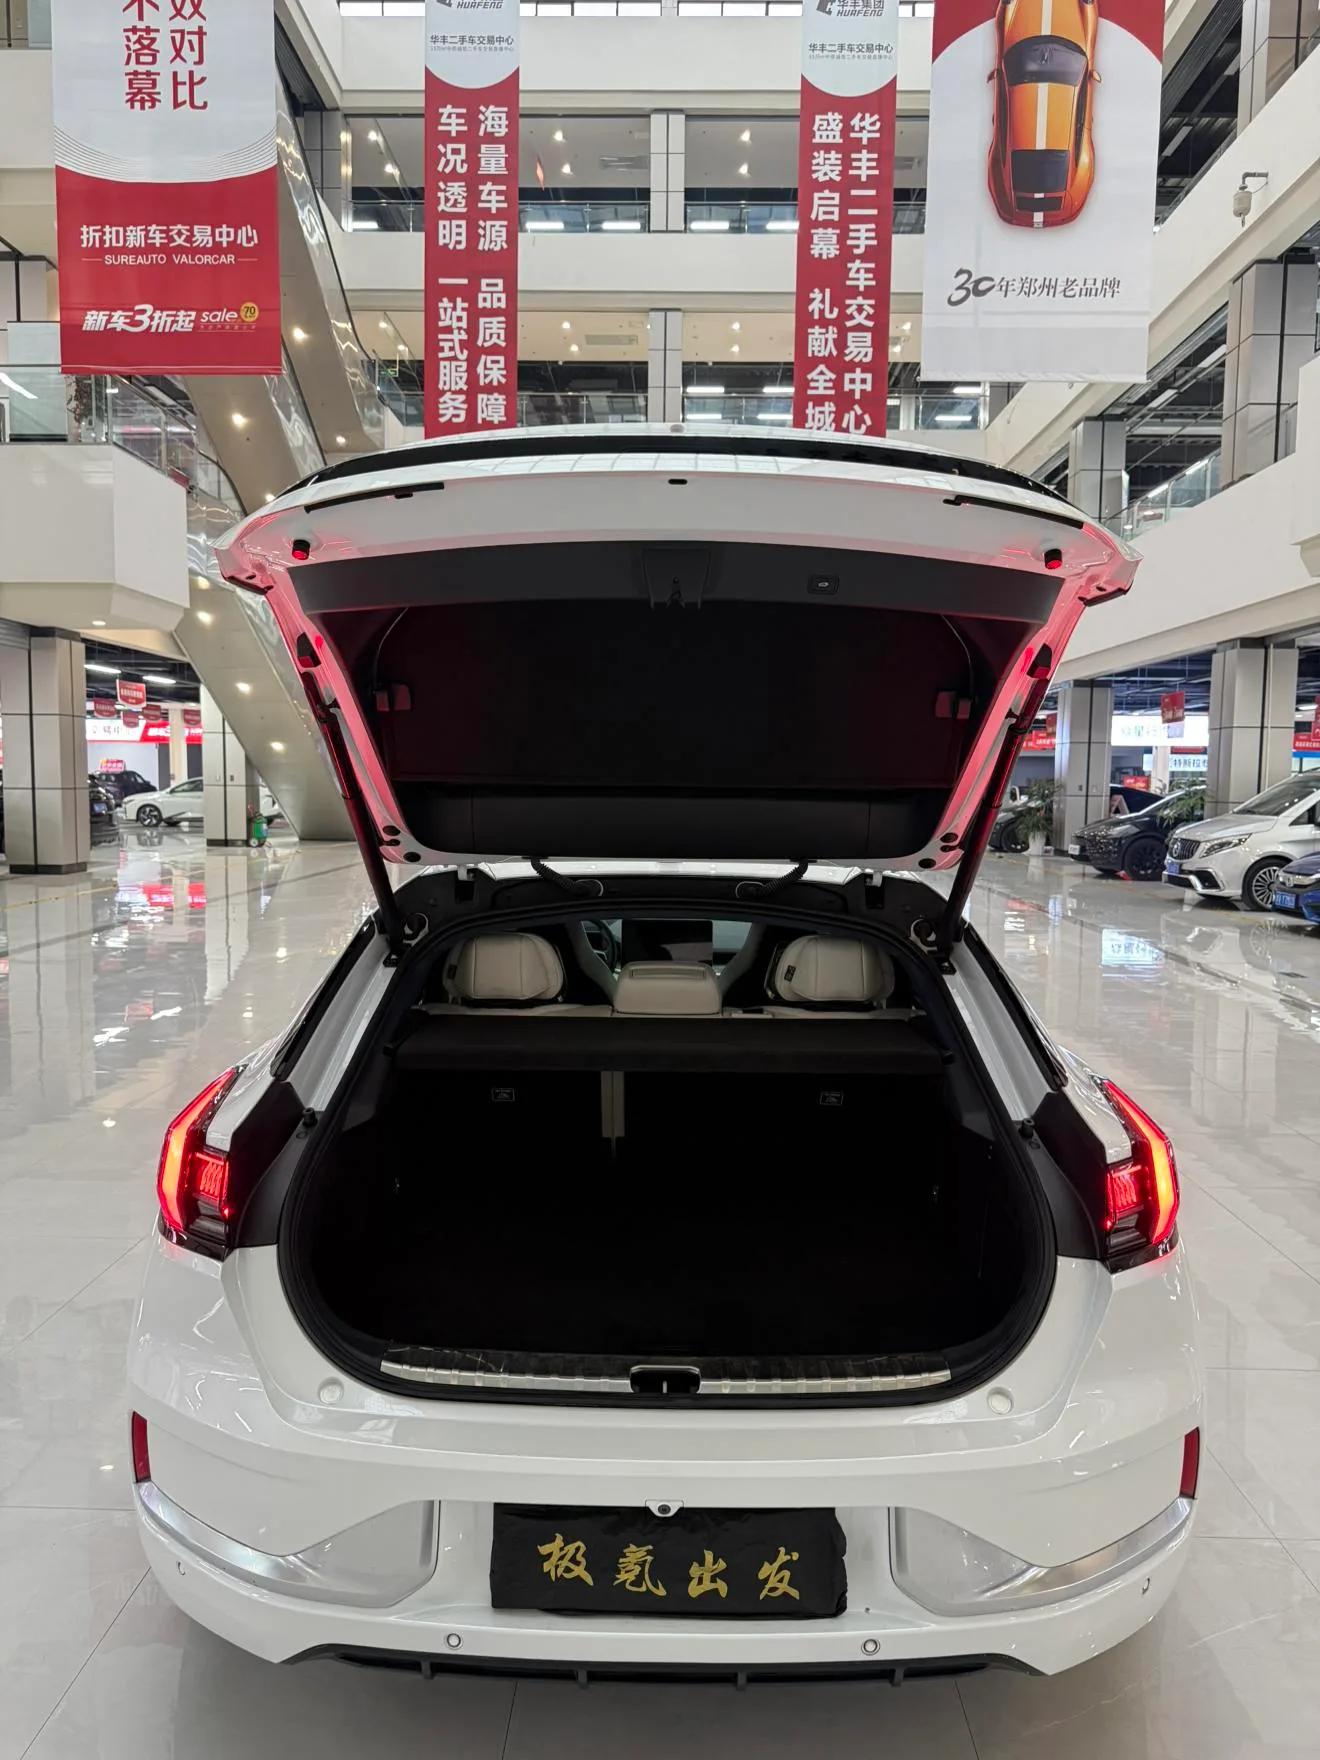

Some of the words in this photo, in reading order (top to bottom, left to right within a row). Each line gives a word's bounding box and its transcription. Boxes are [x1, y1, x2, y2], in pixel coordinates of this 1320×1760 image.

[837, 9, 884, 17] HUAFENG
[429, 34, 514, 45] 华丰二手车交易中心
[808, 43, 894, 53] 华丰二手车交易中心
[437, 104, 468, 250] 车况透明
[477, 104, 508, 251] 海量车源
[810, 111, 843, 260] 盛装启幕
[80, 224, 258, 248] 折扣新车交易中心
[104, 254, 167, 265] SUREAUTO
[172, 254, 236, 265] VALORCAR
[841, 112, 881, 434] 华丰二手车交易中心
[947, 267, 1121, 307] 30年郑州老品牌
[82, 303, 197, 333] 新车3折起
[200, 308, 238, 322] sale
[243, 306, 256, 315] 70
[437, 277, 468, 423] 一站式服务
[476, 278, 507, 424] 品质保障
[804, 287, 839, 432] 礼献全城
[537, 1533, 800, 1600] 极氪出发
